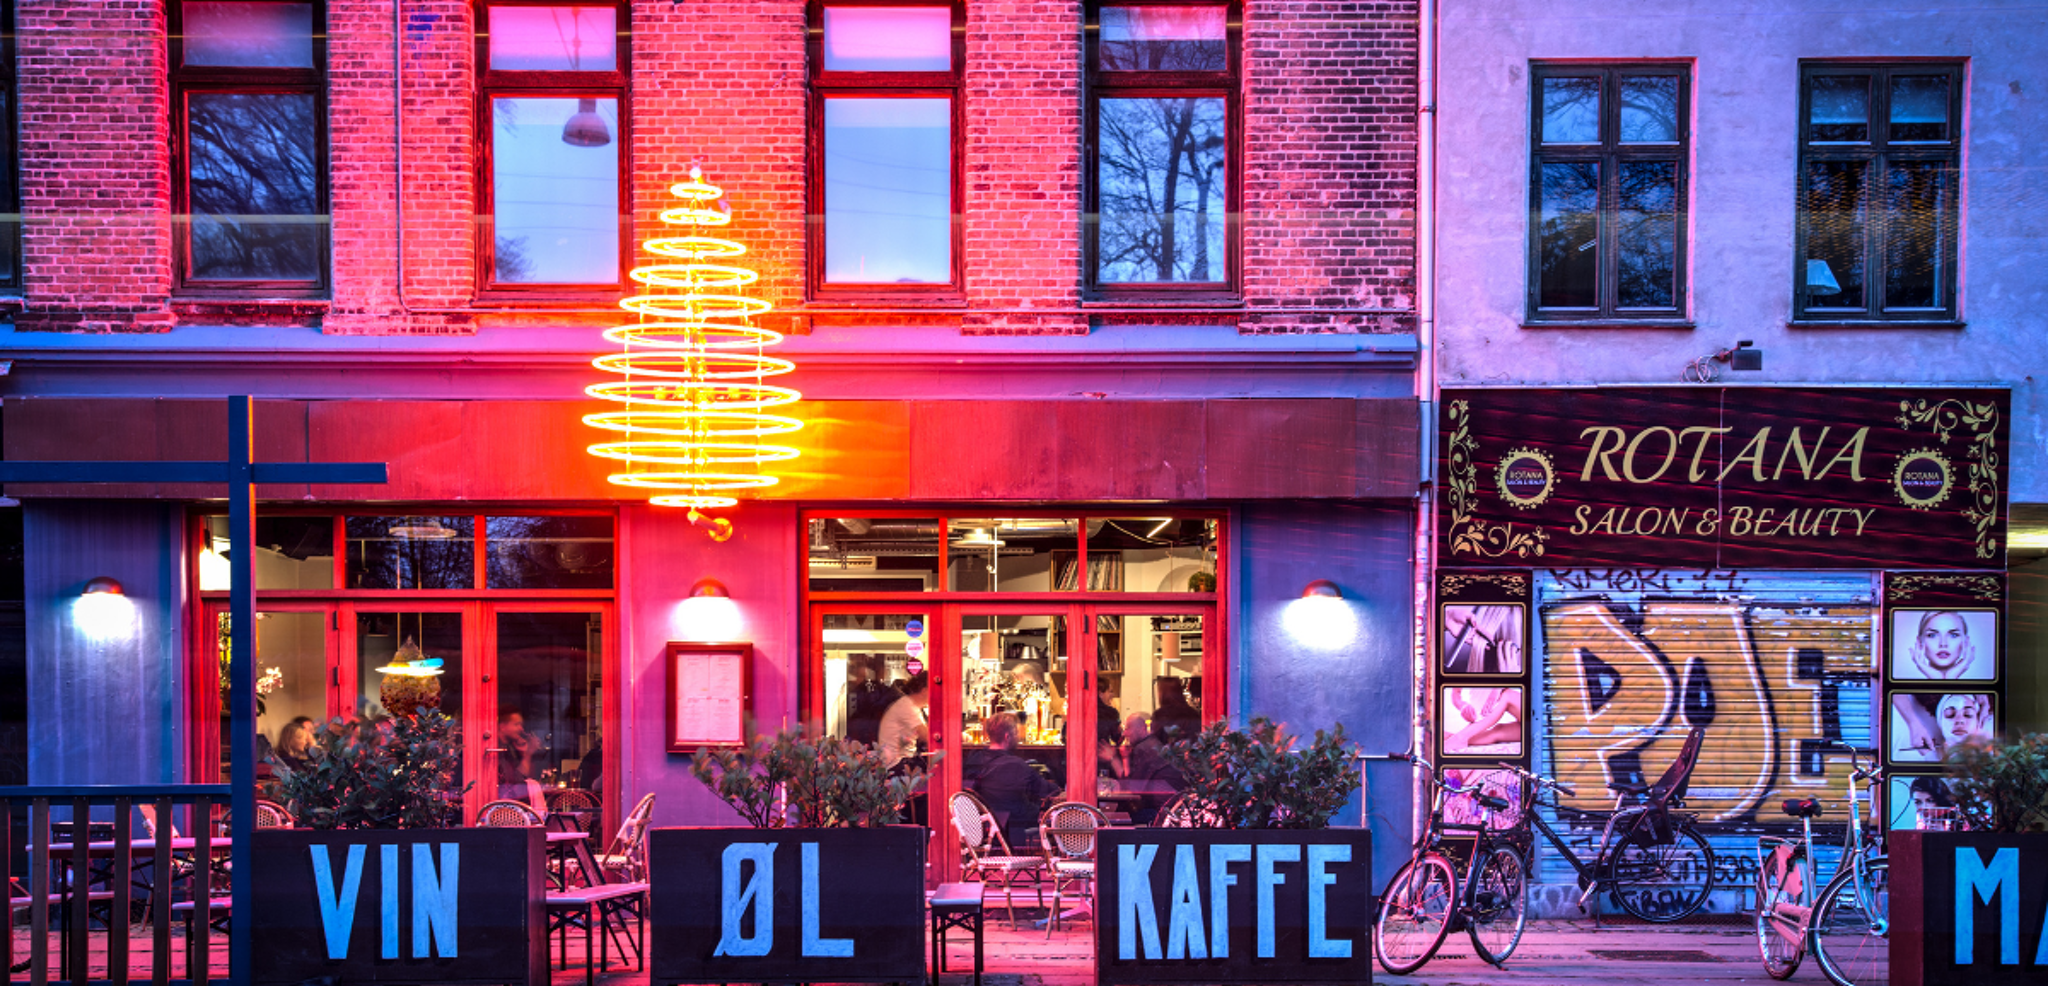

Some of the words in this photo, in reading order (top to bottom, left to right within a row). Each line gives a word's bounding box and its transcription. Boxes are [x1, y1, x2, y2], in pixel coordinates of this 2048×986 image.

[1510, 471, 1543, 479] ROTANA
[1579, 425, 1870, 484] ROTANA
[1905, 472, 1939, 480] ROTANA
[1569, 504, 1689, 536] SALON
[1695, 508, 1721, 536] &
[1728, 505, 1877, 537] BEAUTY
[309, 842, 460, 960] VIN
[712, 841, 855, 958] ØL
[1117, 843, 1353, 960] KAFFE
[1955, 846, 2048, 966] M
